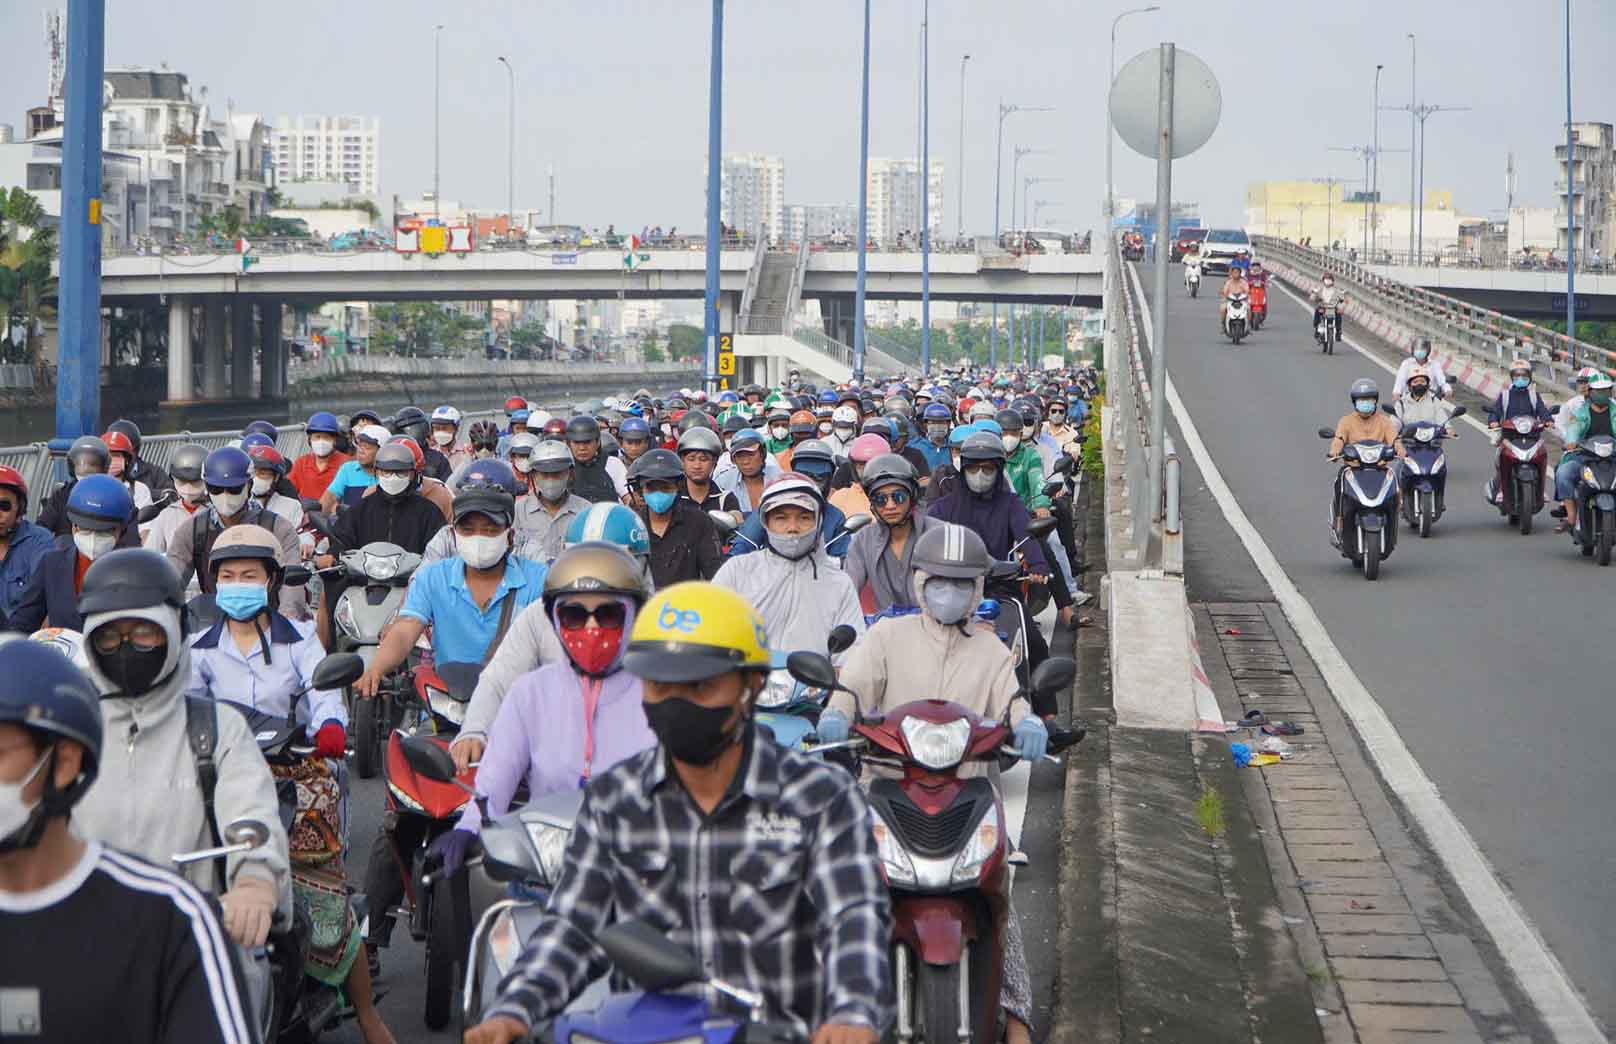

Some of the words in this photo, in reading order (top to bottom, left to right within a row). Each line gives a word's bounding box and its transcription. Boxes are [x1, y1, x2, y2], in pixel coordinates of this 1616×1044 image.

[720, 335, 731, 350] 2
[721, 357, 730, 370] 3
[658, 601, 702, 632] be
